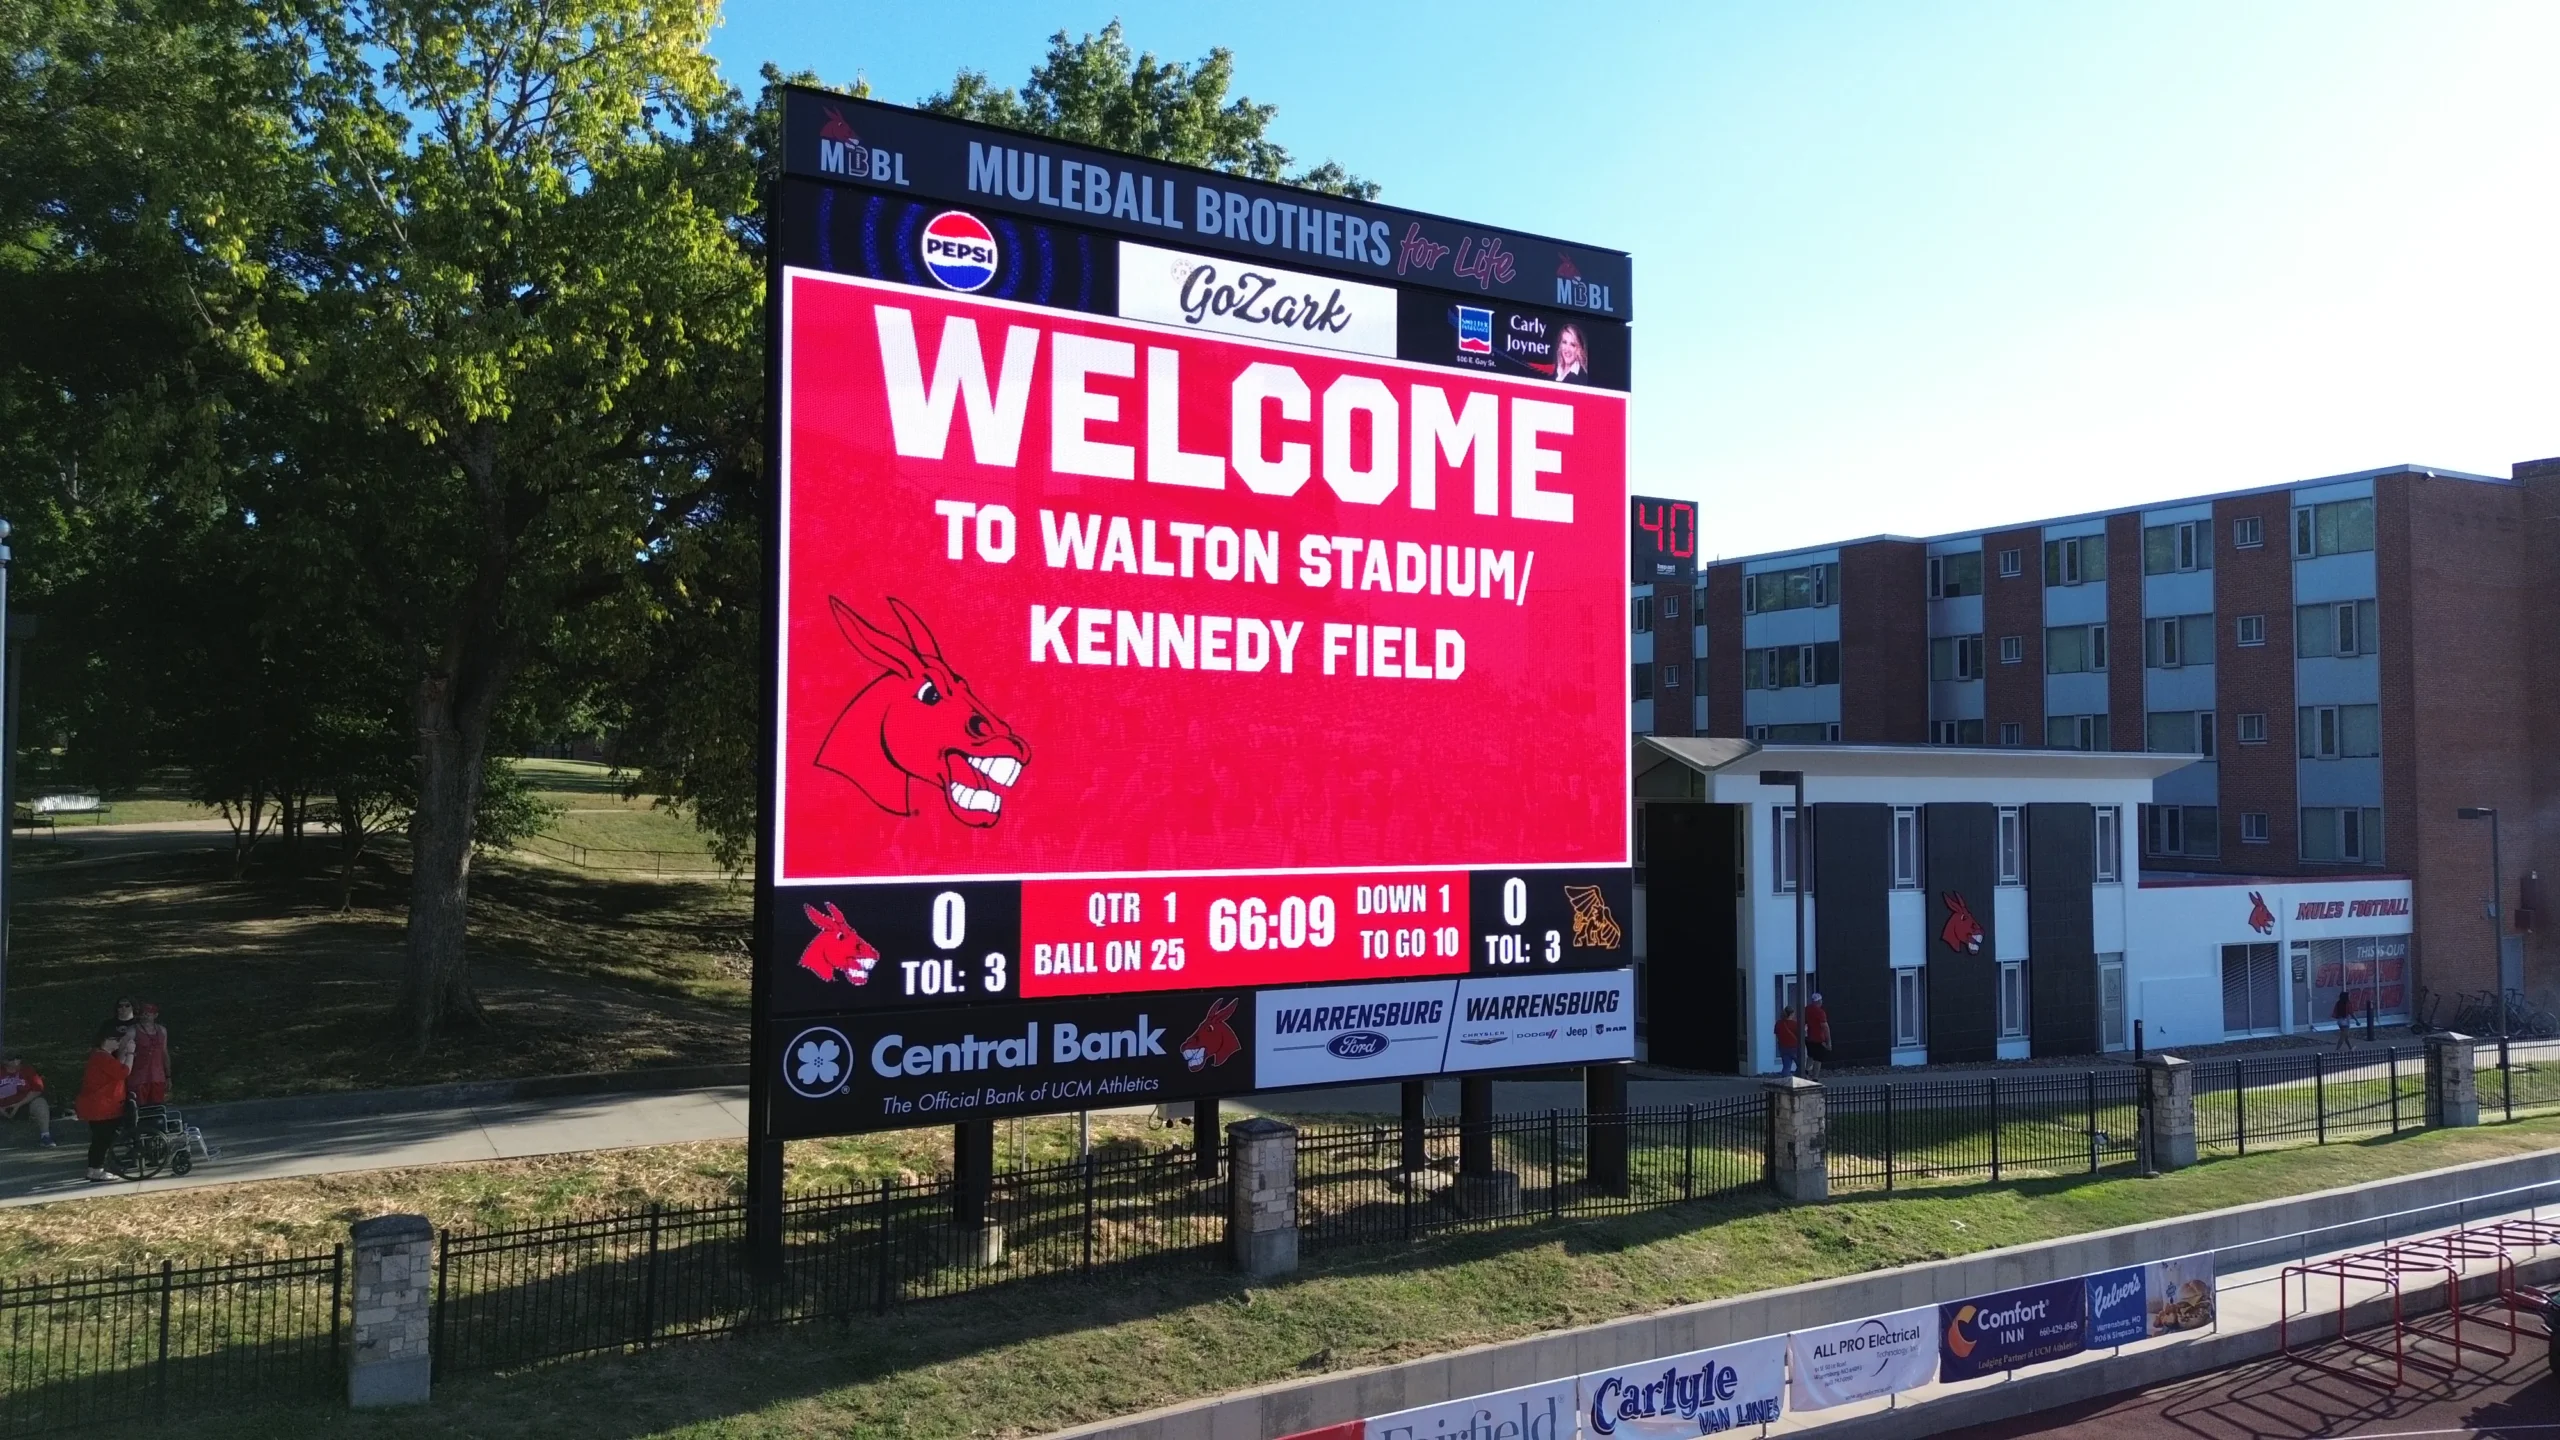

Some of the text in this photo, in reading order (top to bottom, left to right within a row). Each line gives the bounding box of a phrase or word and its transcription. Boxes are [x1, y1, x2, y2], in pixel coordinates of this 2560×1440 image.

[968, 141, 1516, 289] MULEBALL BROTHERS for Life
[927, 238, 993, 264] PEPSI
[1180, 265, 1352, 333] GoZark
[1510, 314, 1547, 337] Carly
[1507, 334, 1551, 355] Joyner
[874, 304, 1574, 523] WELCOME
[1640, 503, 1694, 558] 40
[935, 499, 1534, 606] TO WALTON STADIUM/
[1030, 604, 1466, 680] KENNEDY FIELD
[1089, 891, 1177, 927] QTR 1
[1357, 884, 1449, 915] DOWN 1
[1503, 877, 1526, 926] 0
[2296, 898, 2409, 920] MULES FOOTBALL
[932, 891, 966, 950] 0
[1209, 895, 1335, 951] 66:09
[1034, 938, 1185, 975] BALL ON 25
[1360, 926, 1459, 959] TO GO 10
[1485, 930, 1560, 964] TOL: 3
[2357, 946, 2374, 958] THIS
[2386, 944, 2405, 957] OUR
[902, 952, 1006, 995] TOL: 3
[1275, 1000, 1443, 1035] WARRENSBURG
[1466, 990, 1620, 1022] WARRENSBURG
[871, 1014, 1167, 1078] Central Bank
[1339, 1033, 1376, 1055] Ford
[1566, 1026, 1588, 1037] Jeep
[883, 1075, 1159, 1114] The Official Bank of UCM Athletics
[2094, 1272, 2141, 1319] Culver's
[1978, 1300, 2046, 1330] Comfort
[1813, 1326, 1920, 1360] ALL PRO Electrical
[2001, 1328, 2025, 1344] INN
[1978, 1356, 2003, 1370] Lodging
[2003, 1351, 2027, 1364] Partner
[1591, 1360, 1737, 1435] Carlyle
[1698, 1396, 1780, 1435] VAN LINES
